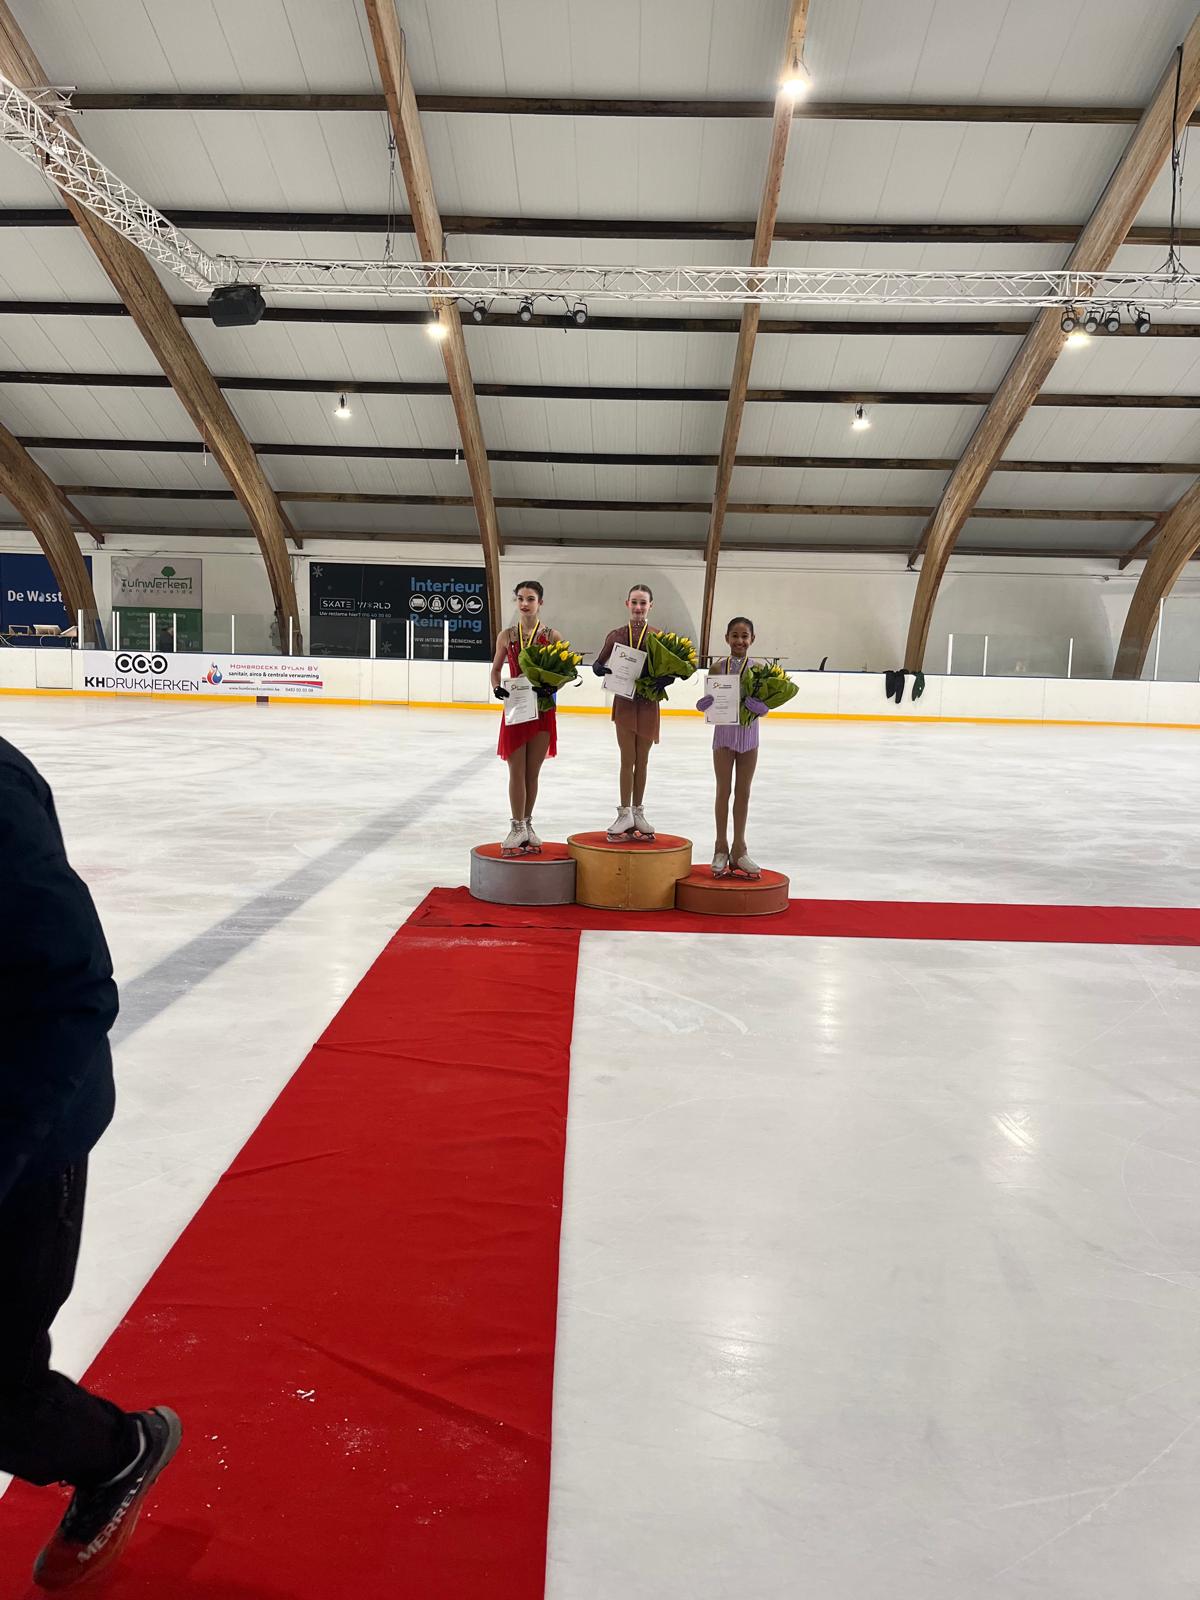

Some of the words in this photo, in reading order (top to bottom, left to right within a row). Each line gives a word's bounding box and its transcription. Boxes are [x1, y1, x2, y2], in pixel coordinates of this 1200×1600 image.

[410, 576, 484, 593] Interieur
[7, 590, 24, 602] De
[322, 600, 352, 608] SKATE
[409, 613, 482, 633] Reinging
